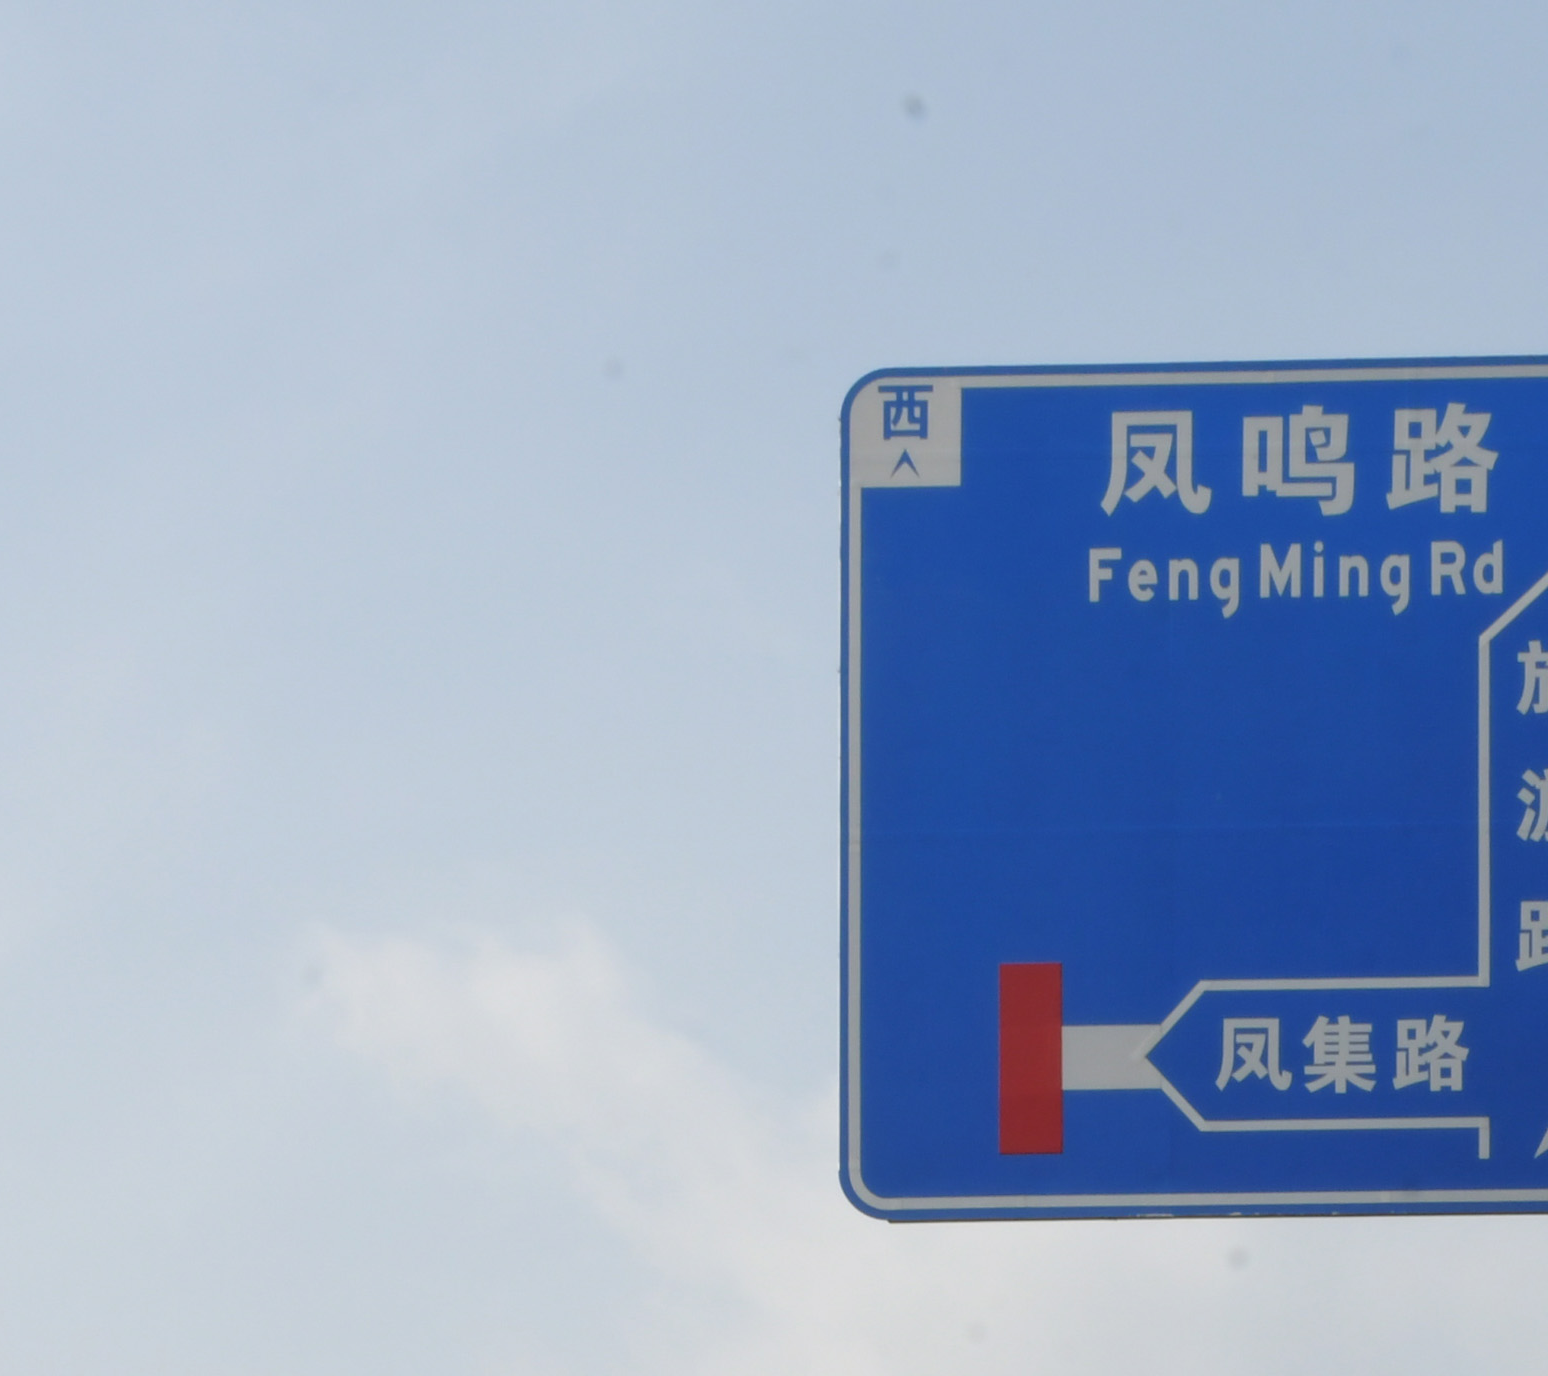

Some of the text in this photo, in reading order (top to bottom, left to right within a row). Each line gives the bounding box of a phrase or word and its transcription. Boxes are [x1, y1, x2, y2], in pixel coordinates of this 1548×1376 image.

[877, 384, 934, 441] 西
[1100, 402, 1499, 516] 凤鸣路
[1088, 539, 1504, 618] Feng Ming Rd
[1215, 1014, 1470, 1094] 凤集路
